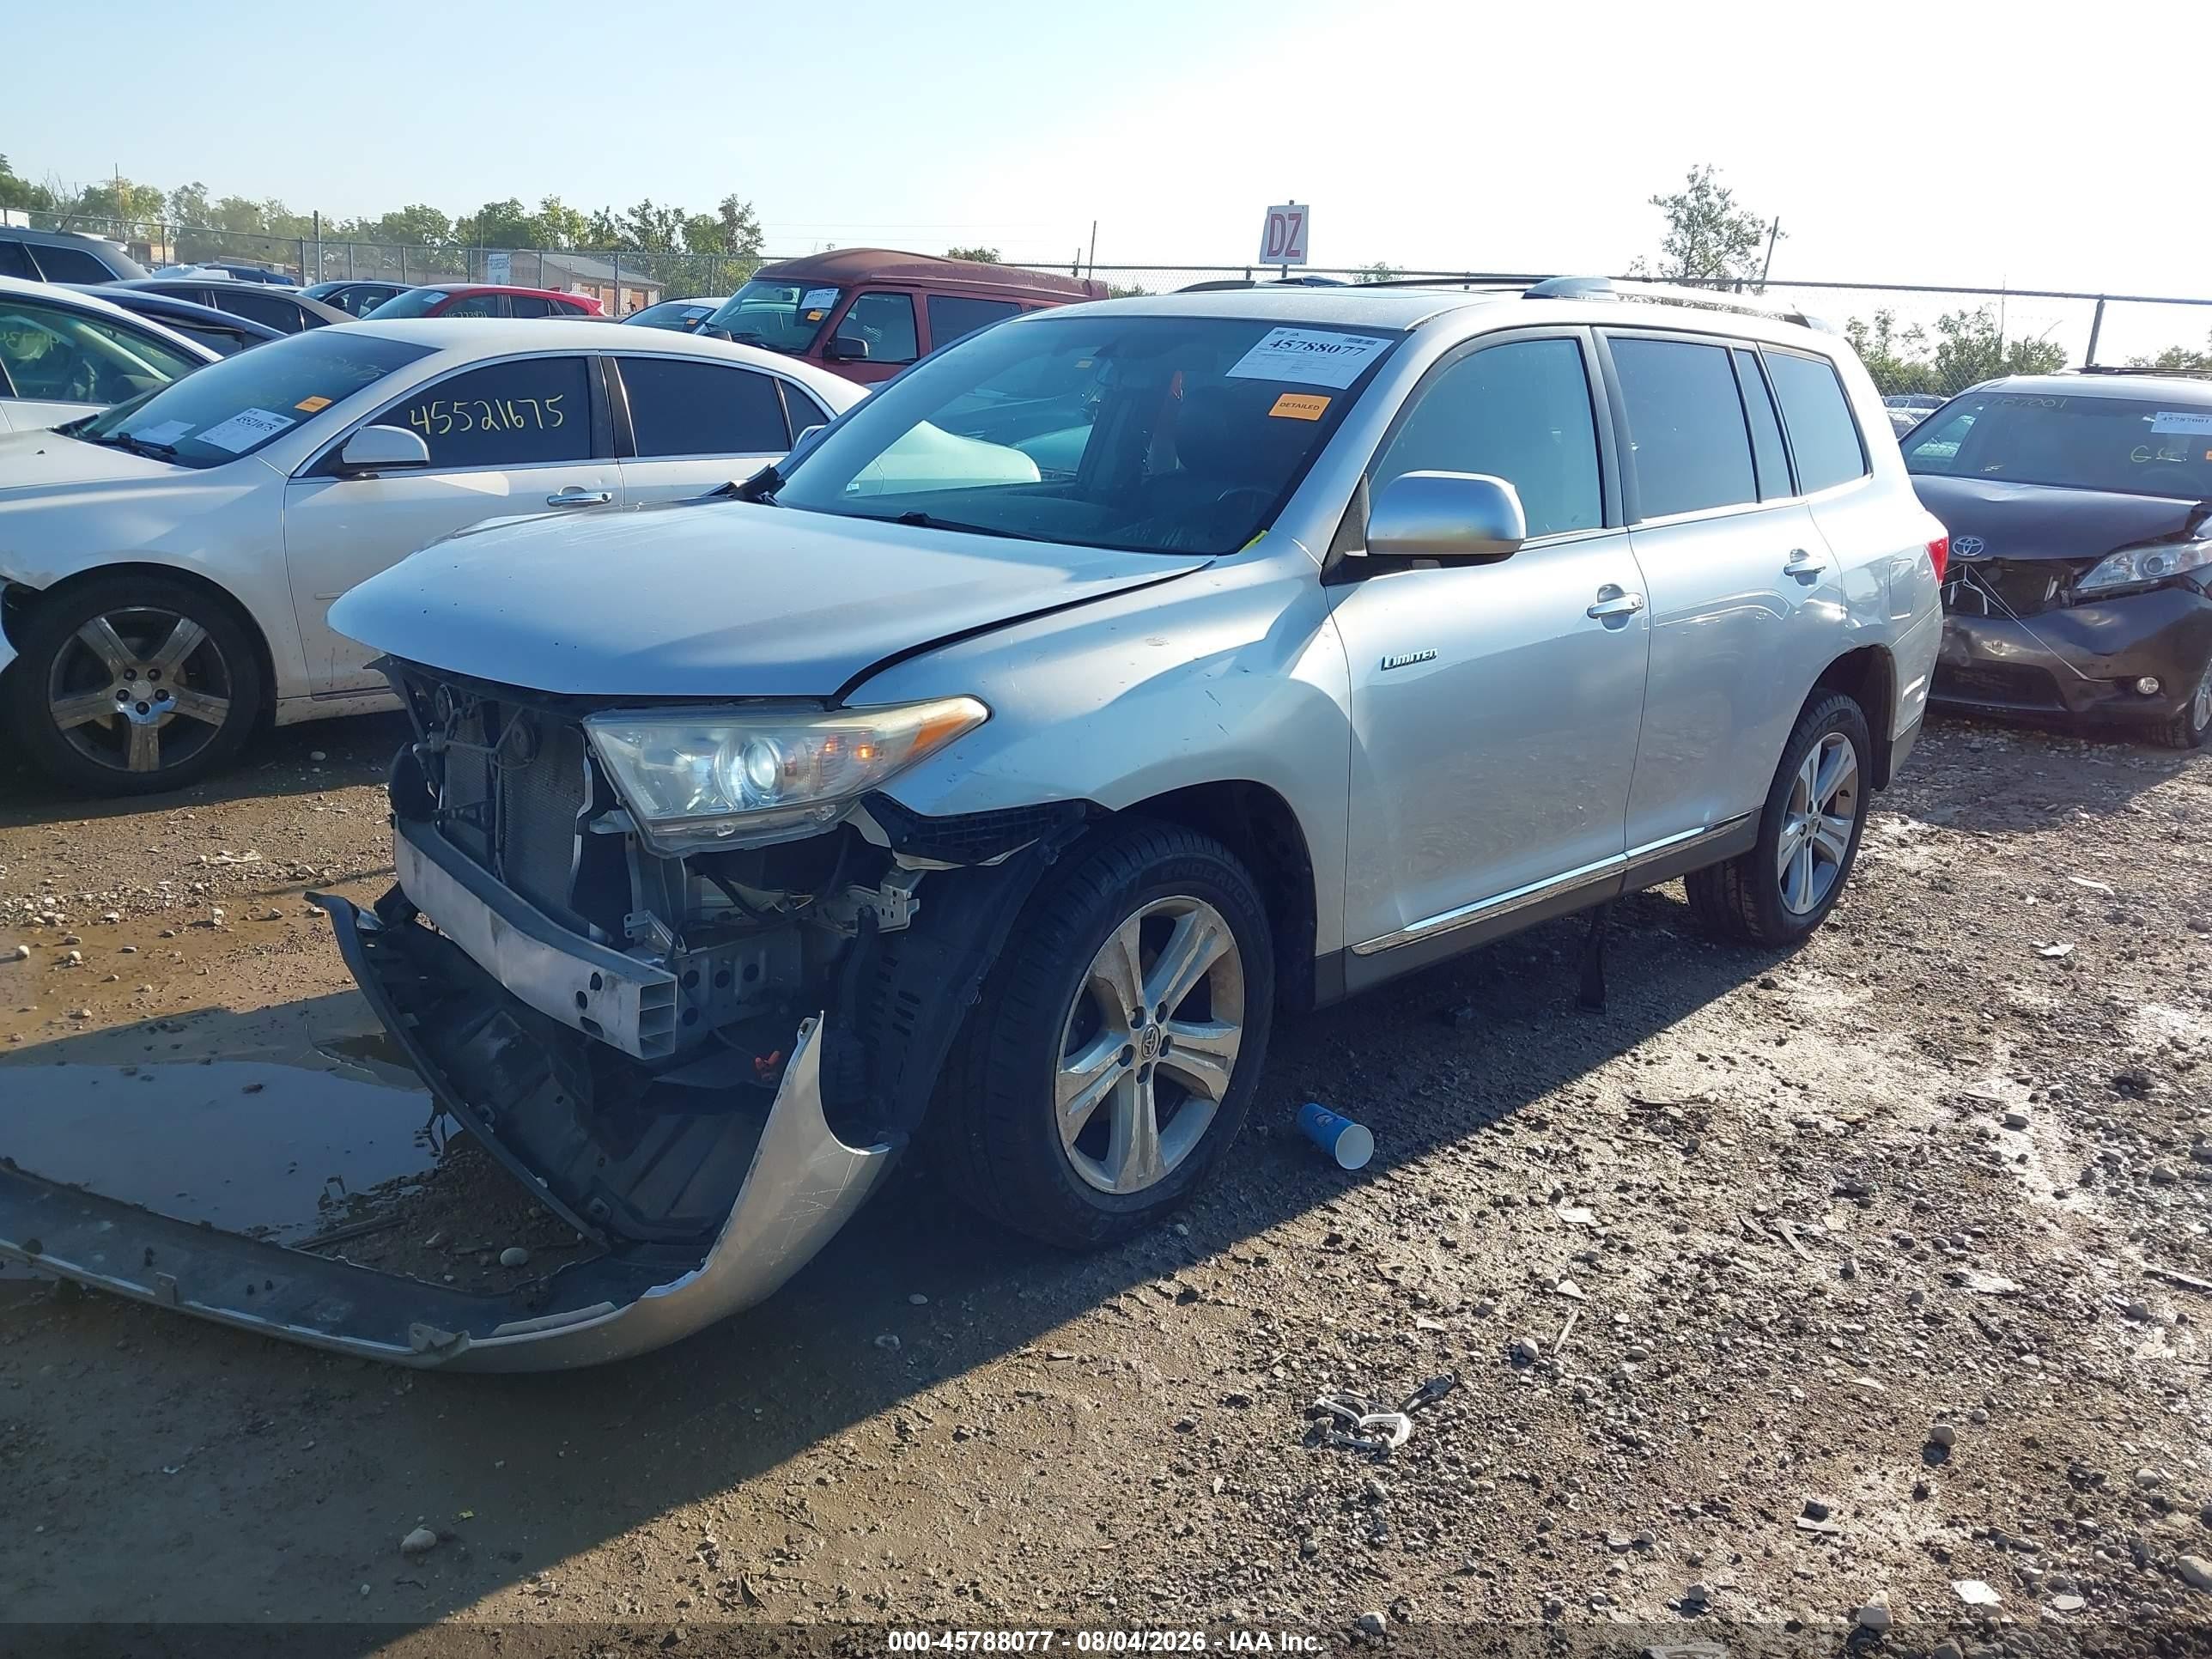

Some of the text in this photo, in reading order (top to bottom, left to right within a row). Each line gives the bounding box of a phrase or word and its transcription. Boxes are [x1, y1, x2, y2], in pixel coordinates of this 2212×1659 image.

[1267, 213, 1302, 257] DZ
[1269, 338, 1367, 356] 45788077
[410, 394, 564, 434] 45521675
[1279, 401, 1320, 410] DETAILED
